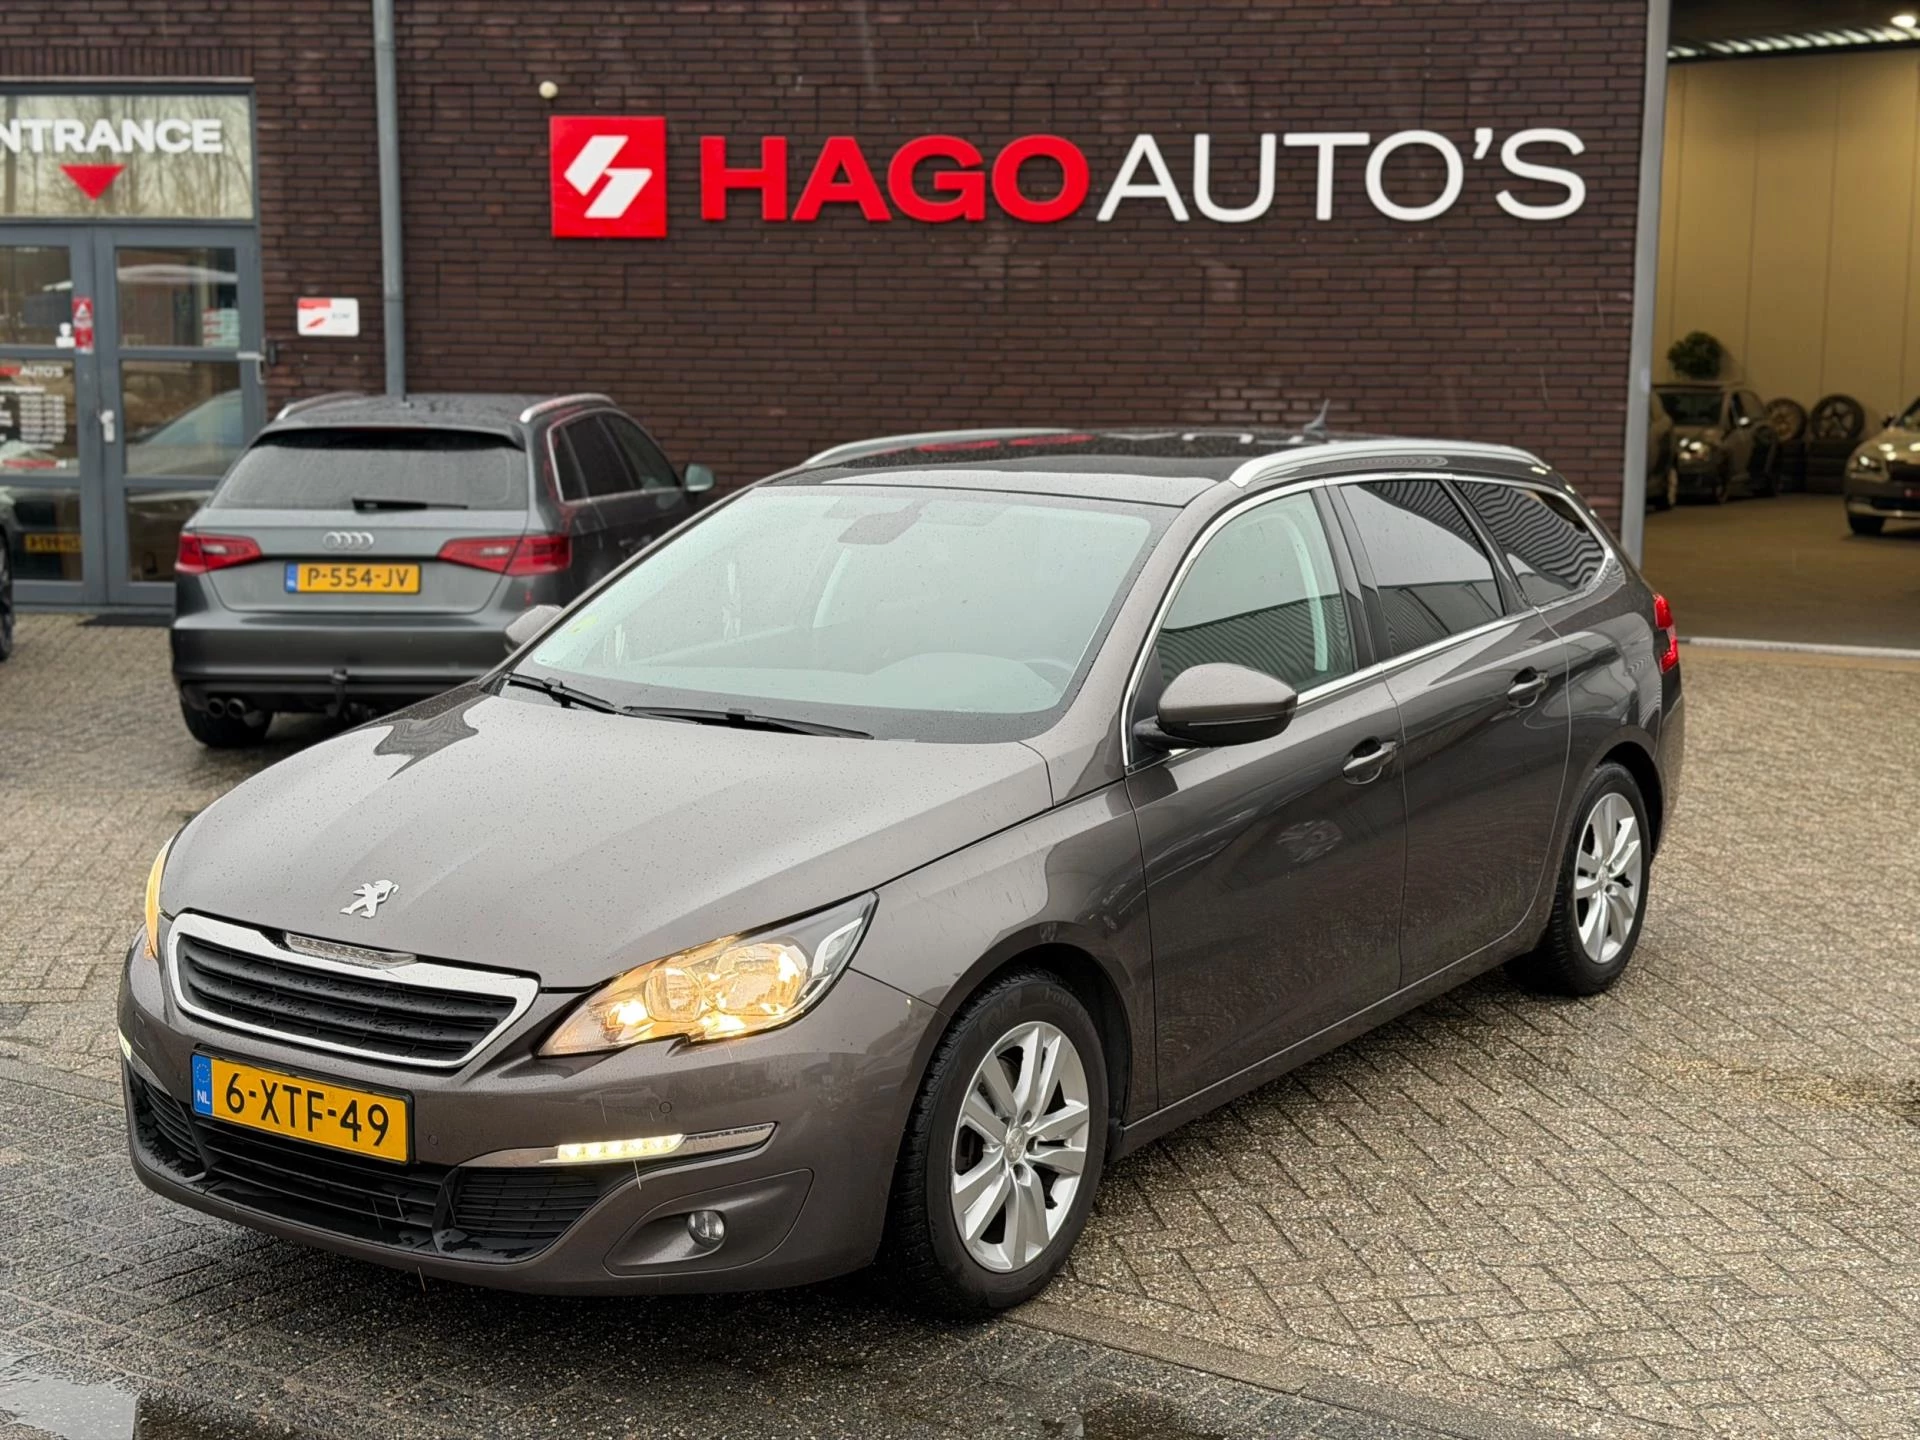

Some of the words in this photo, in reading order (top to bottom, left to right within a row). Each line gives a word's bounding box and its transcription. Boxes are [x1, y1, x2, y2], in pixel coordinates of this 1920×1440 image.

[700, 134, 1090, 222] HAGO
[1096, 127, 1586, 222] AUTO'S
[307, 567, 408, 587] P-554-JV
[196, 1089, 211, 1105] NL
[225, 1072, 389, 1147] 6-XTF-49
